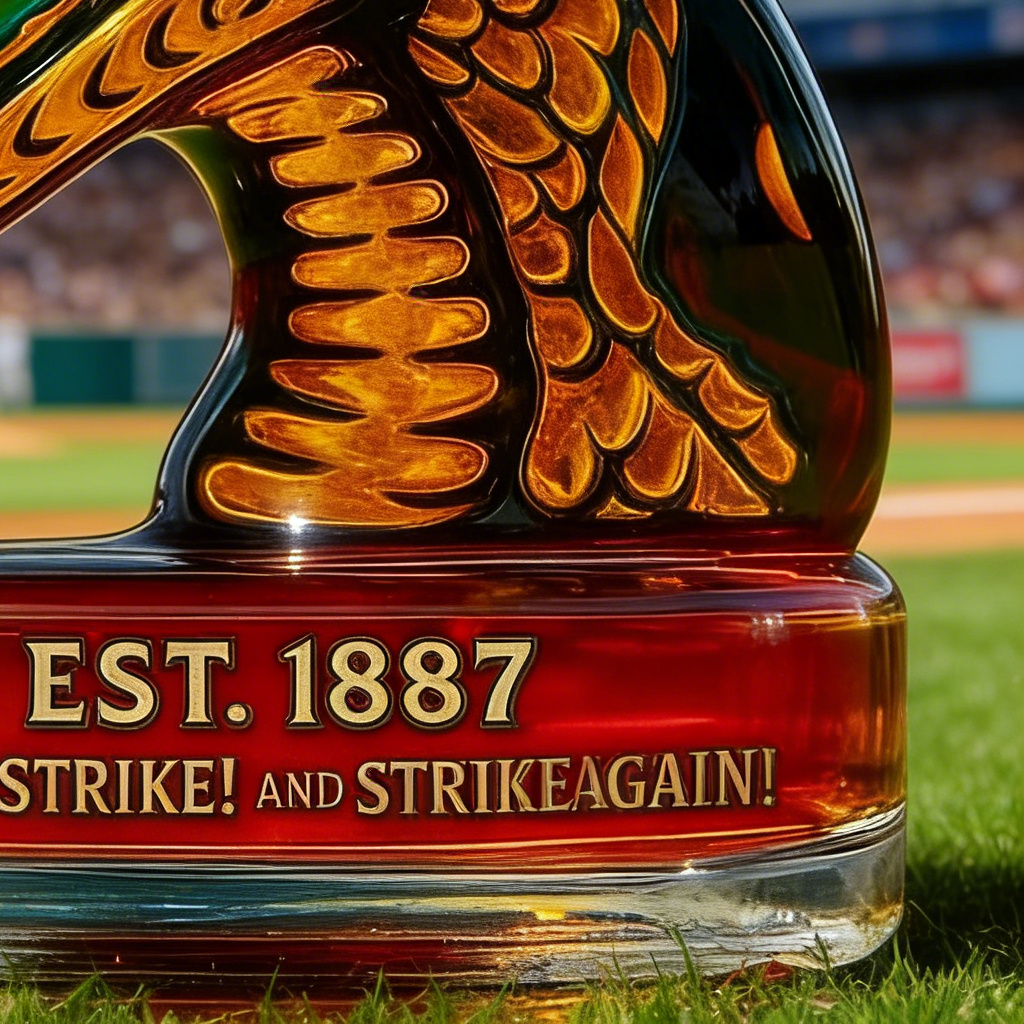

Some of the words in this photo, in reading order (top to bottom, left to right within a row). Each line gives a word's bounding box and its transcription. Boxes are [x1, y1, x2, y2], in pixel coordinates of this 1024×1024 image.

[22, 637, 253, 729] EST.
[279, 634, 537, 729] 1887
[256, 772, 344, 809] AND
